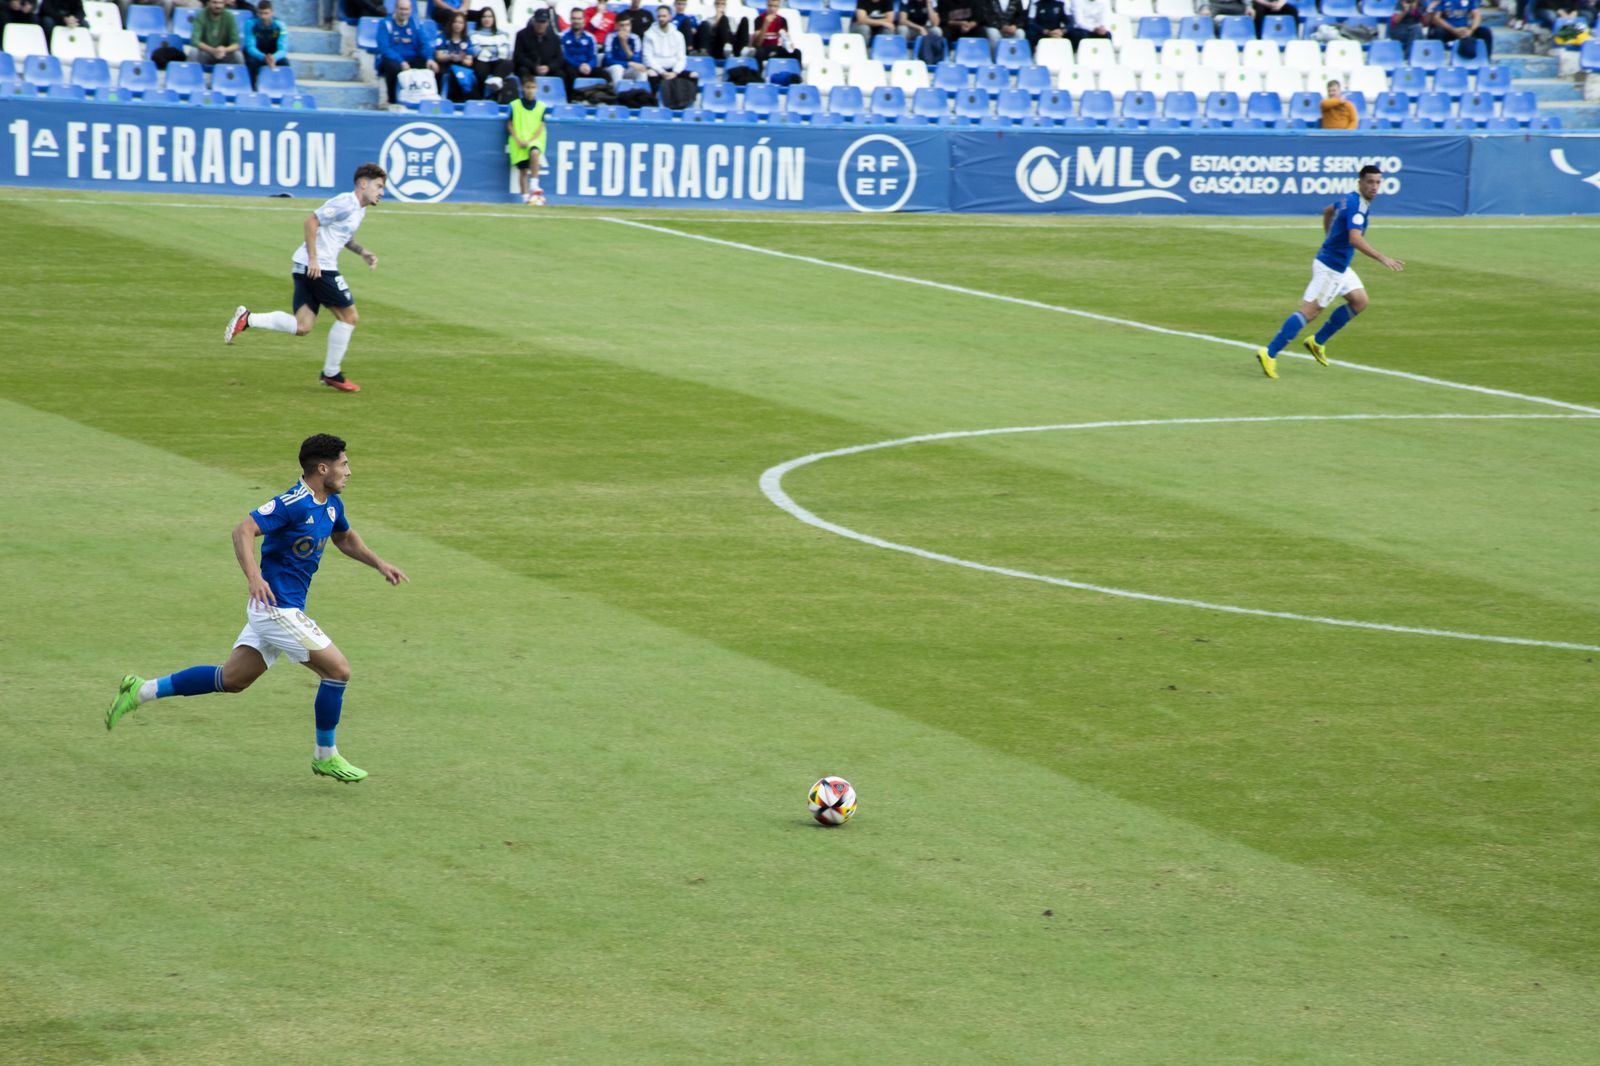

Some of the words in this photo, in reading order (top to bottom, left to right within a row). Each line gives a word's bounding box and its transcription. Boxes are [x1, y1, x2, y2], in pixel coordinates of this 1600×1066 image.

[67, 121, 336, 188] FEDERACIÓN
[407, 151, 434, 163] RF
[857, 155, 900, 173] RF
[1190, 155, 1295, 173] ESTACIONES
[1297, 156, 1320, 173] DE
[406, 165, 434, 177] EF
[556, 136, 806, 201] FEDERACIÓN
[1075, 145, 1182, 189] MLC
[856, 177, 899, 196] EF
[1189, 171, 1280, 195] GASÓLEO
[1281, 176, 1299, 194] A
